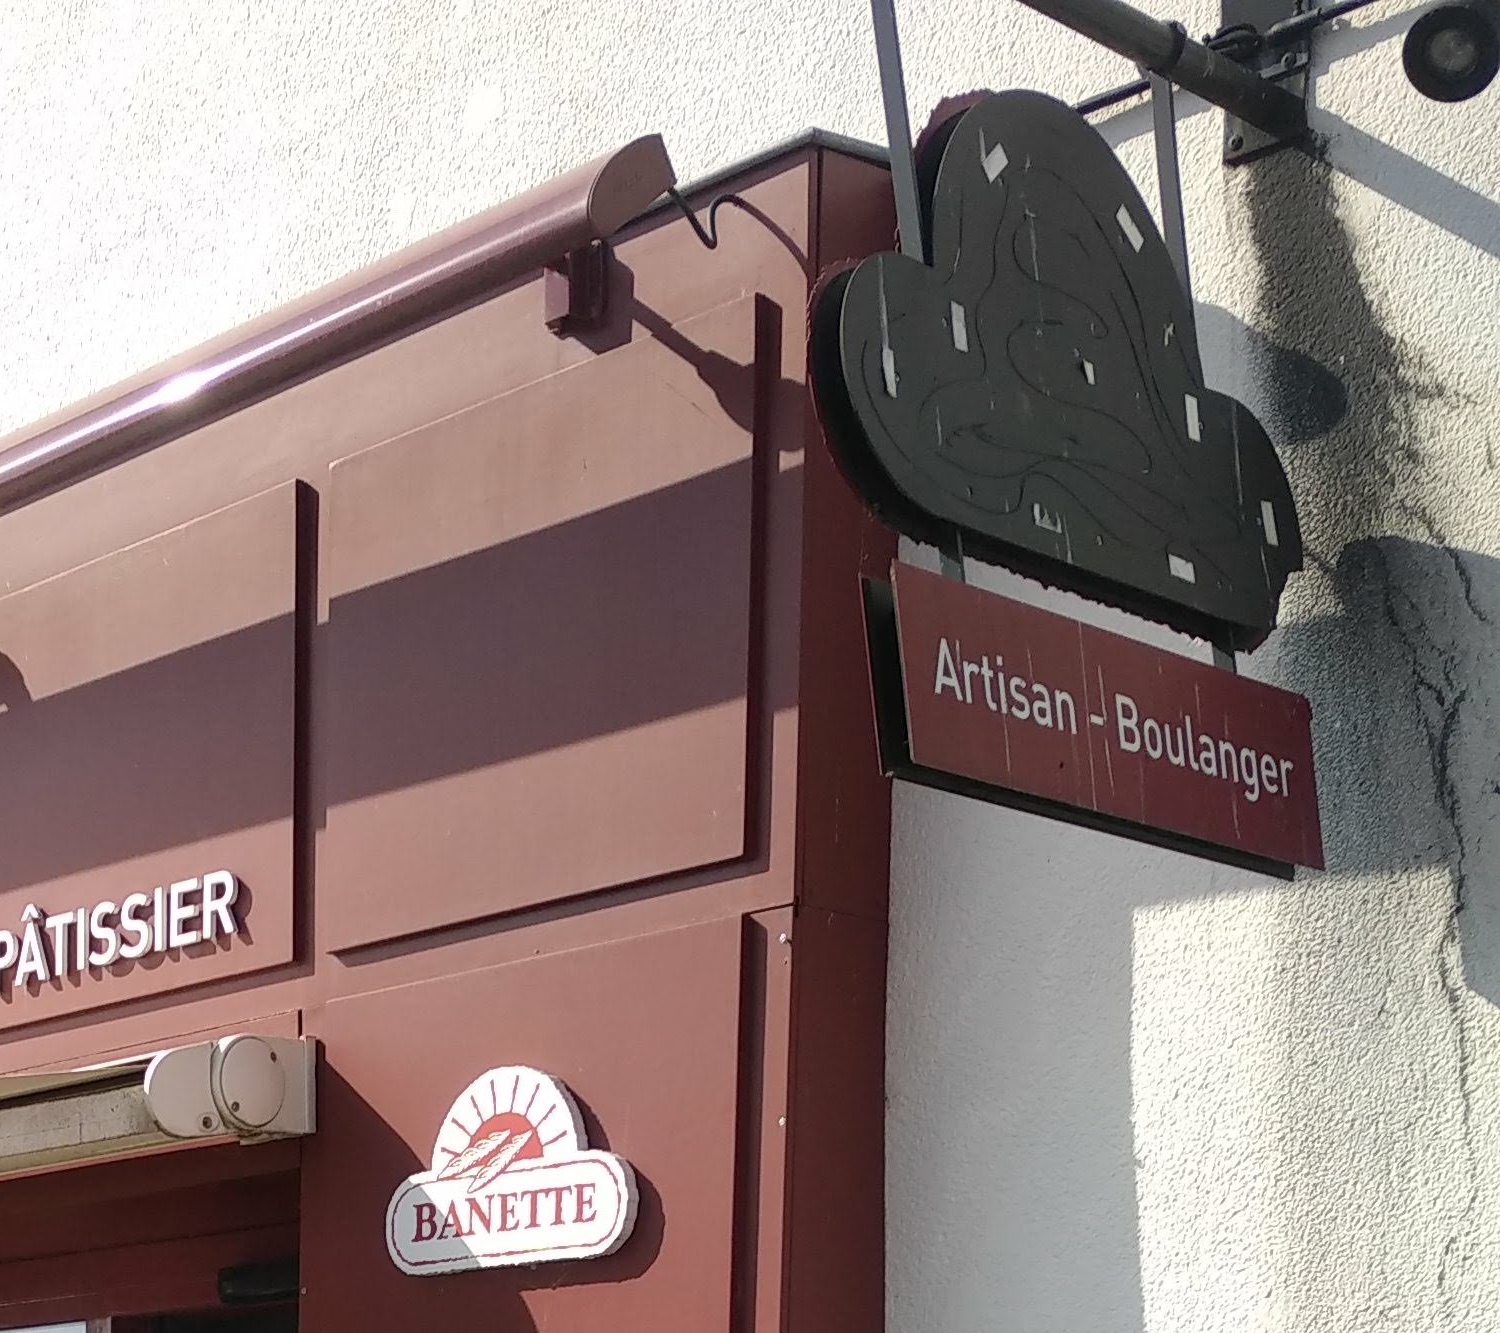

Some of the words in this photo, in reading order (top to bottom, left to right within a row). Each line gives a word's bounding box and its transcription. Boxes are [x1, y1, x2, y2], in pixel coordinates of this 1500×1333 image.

[933, 637, 1078, 736] Artisan
[1117, 693, 1294, 803] Boulanger
[411, 1183, 598, 1243] BANETTE
